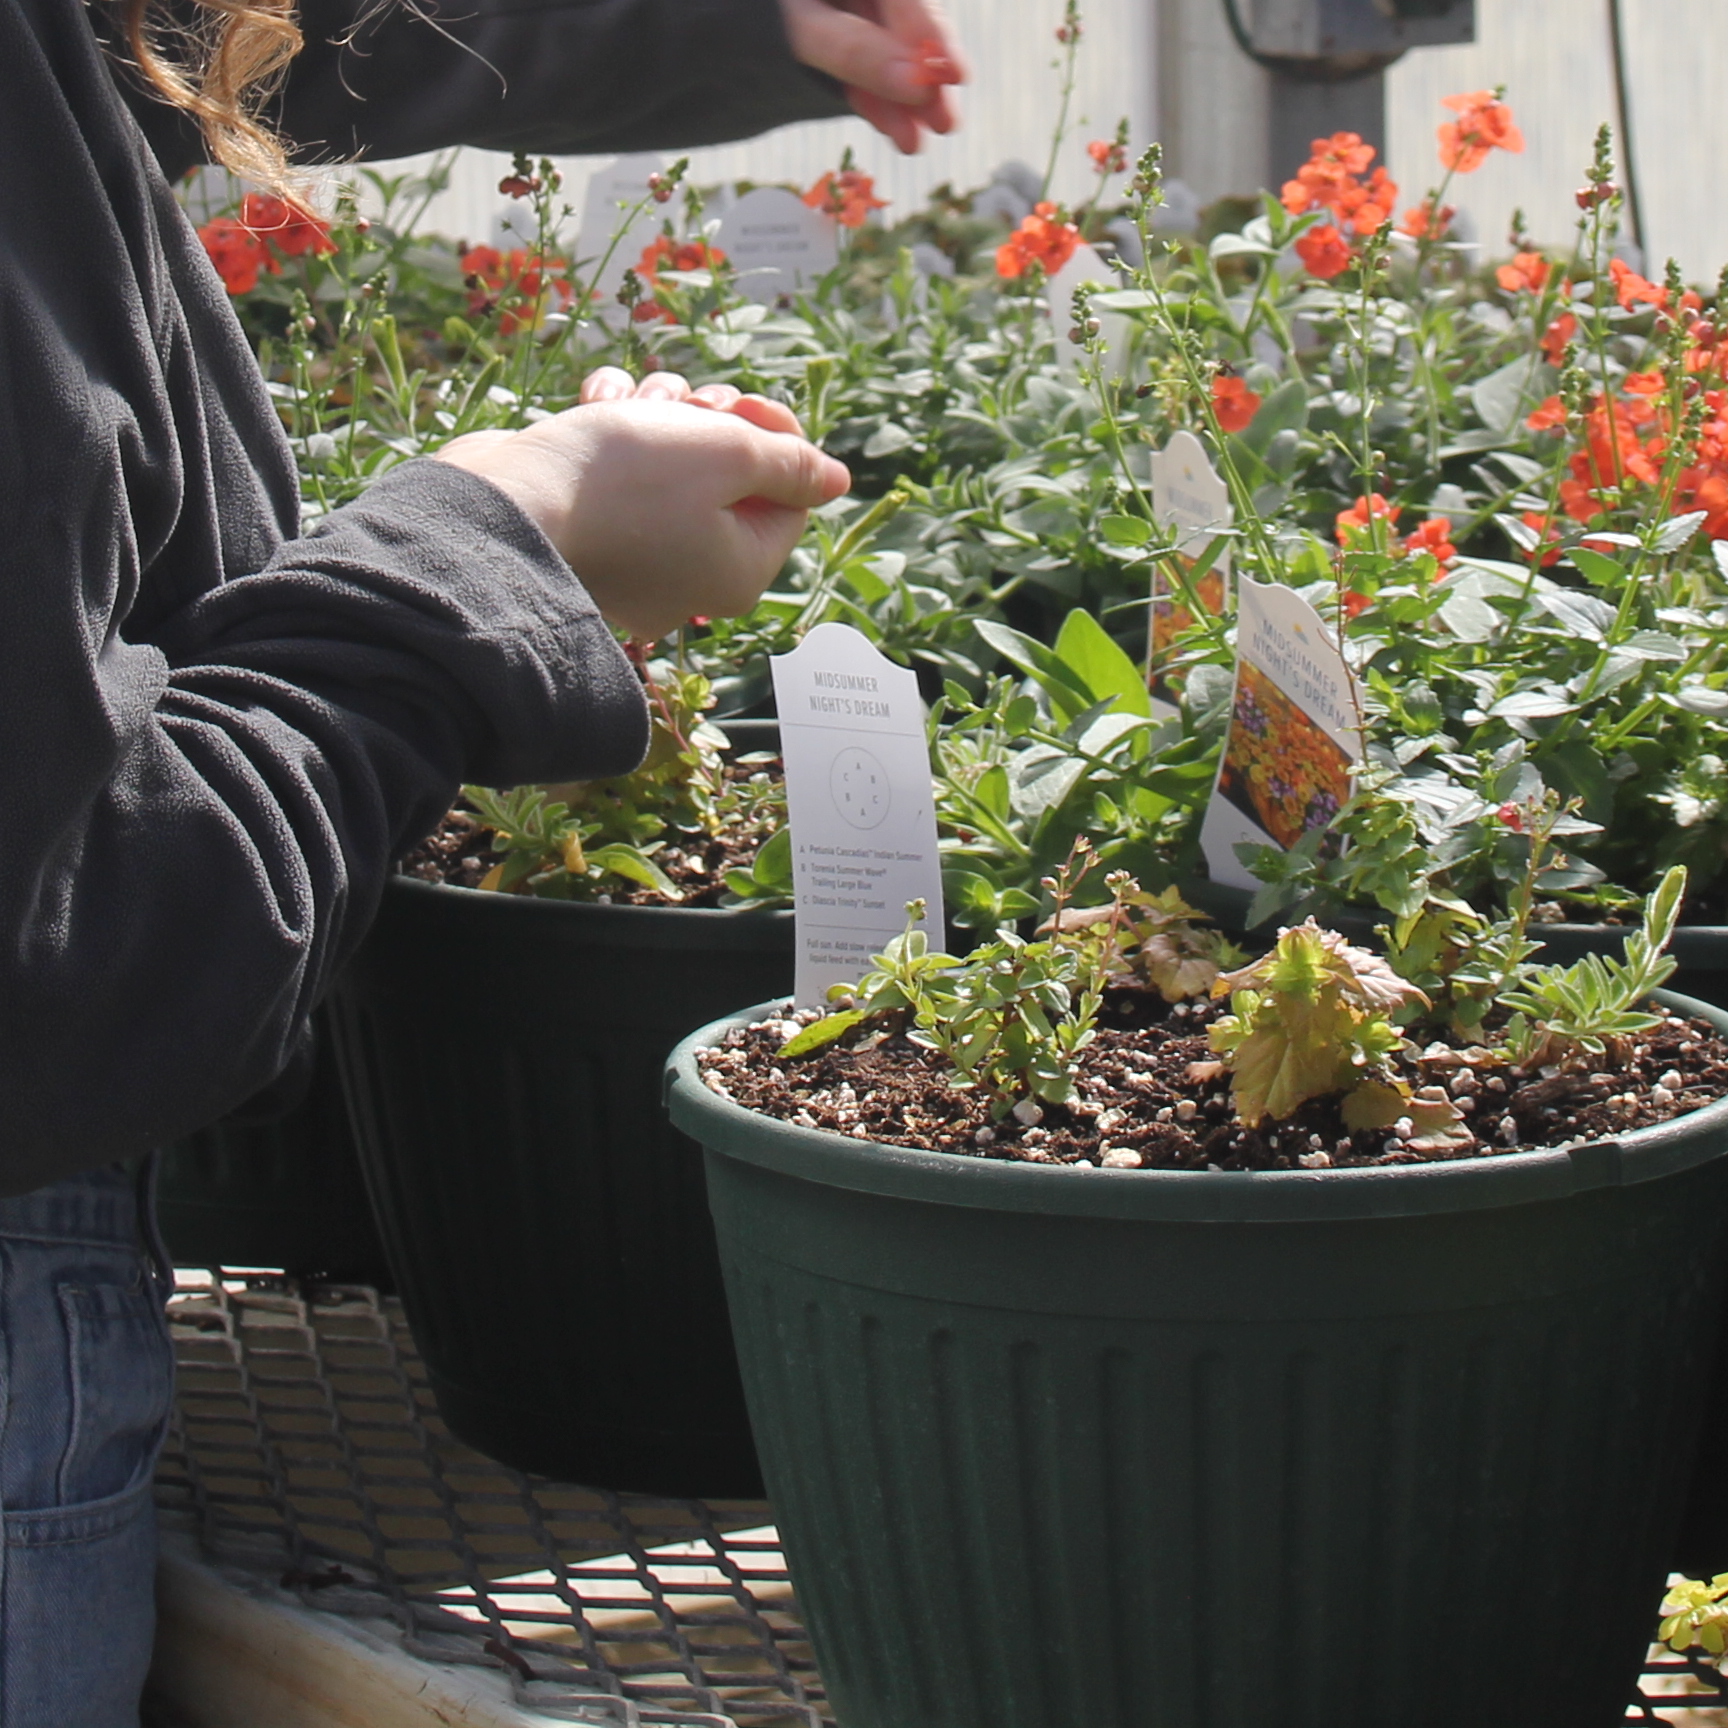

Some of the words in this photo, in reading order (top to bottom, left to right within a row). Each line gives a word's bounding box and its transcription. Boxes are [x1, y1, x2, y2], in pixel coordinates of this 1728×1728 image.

[813, 671, 879, 693] MIDSUMMER
[1253, 633, 1300, 688] NIGHT'S
[1303, 679, 1346, 729] DREAM
[1263, 619, 1338, 698] MIDSUMMER
[809, 695, 852, 715] NIGHT'S
[855, 700, 890, 718] DREAM
